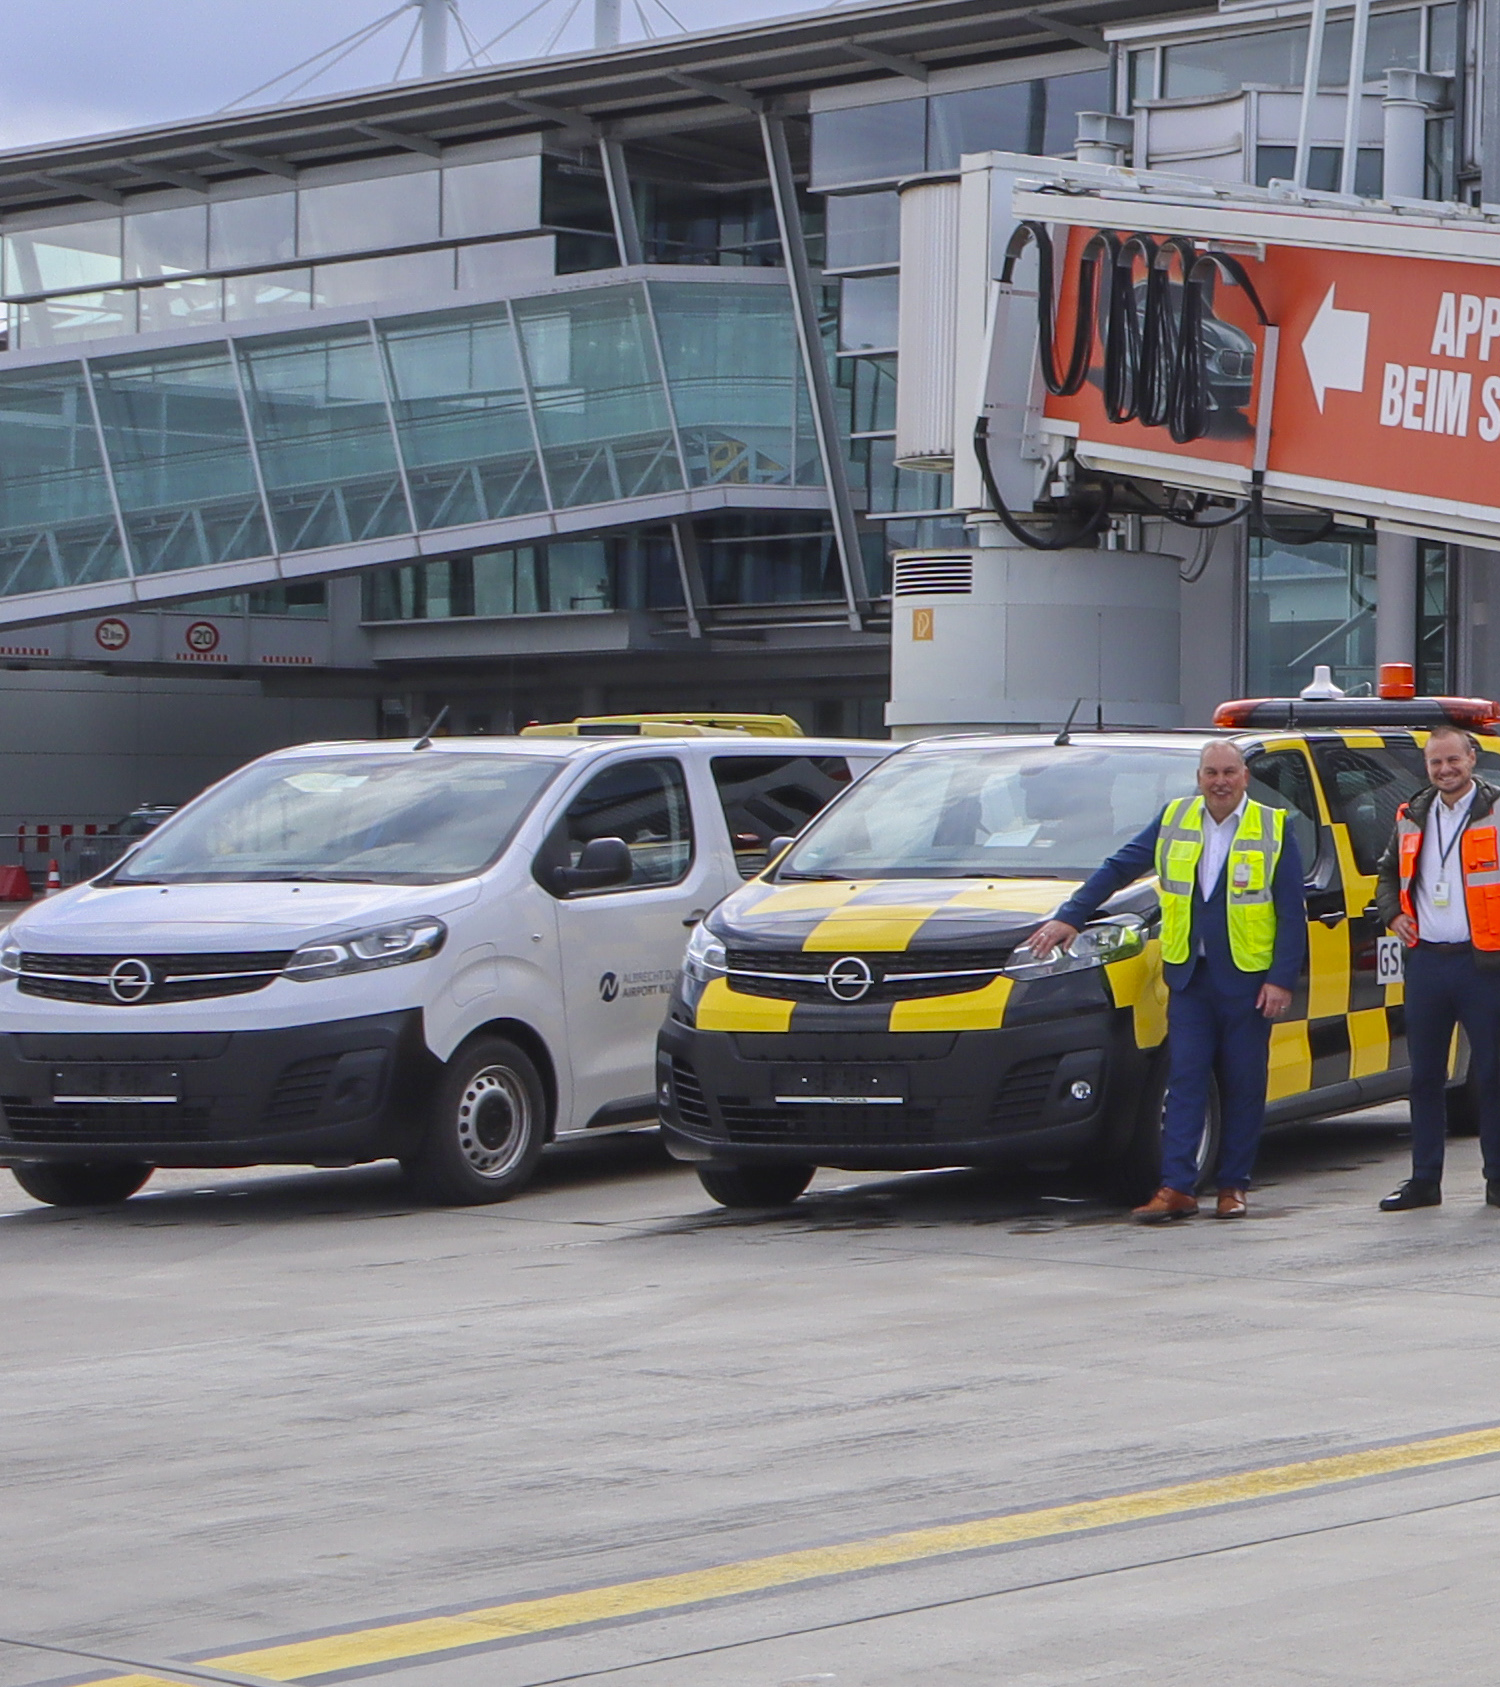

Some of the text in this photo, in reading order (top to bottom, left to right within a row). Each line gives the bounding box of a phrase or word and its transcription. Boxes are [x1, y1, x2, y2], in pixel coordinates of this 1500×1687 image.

[1379, 362, 1472, 438] BEIM
[193, 629, 213, 645] 20
[1380, 942, 1403, 976] GS
